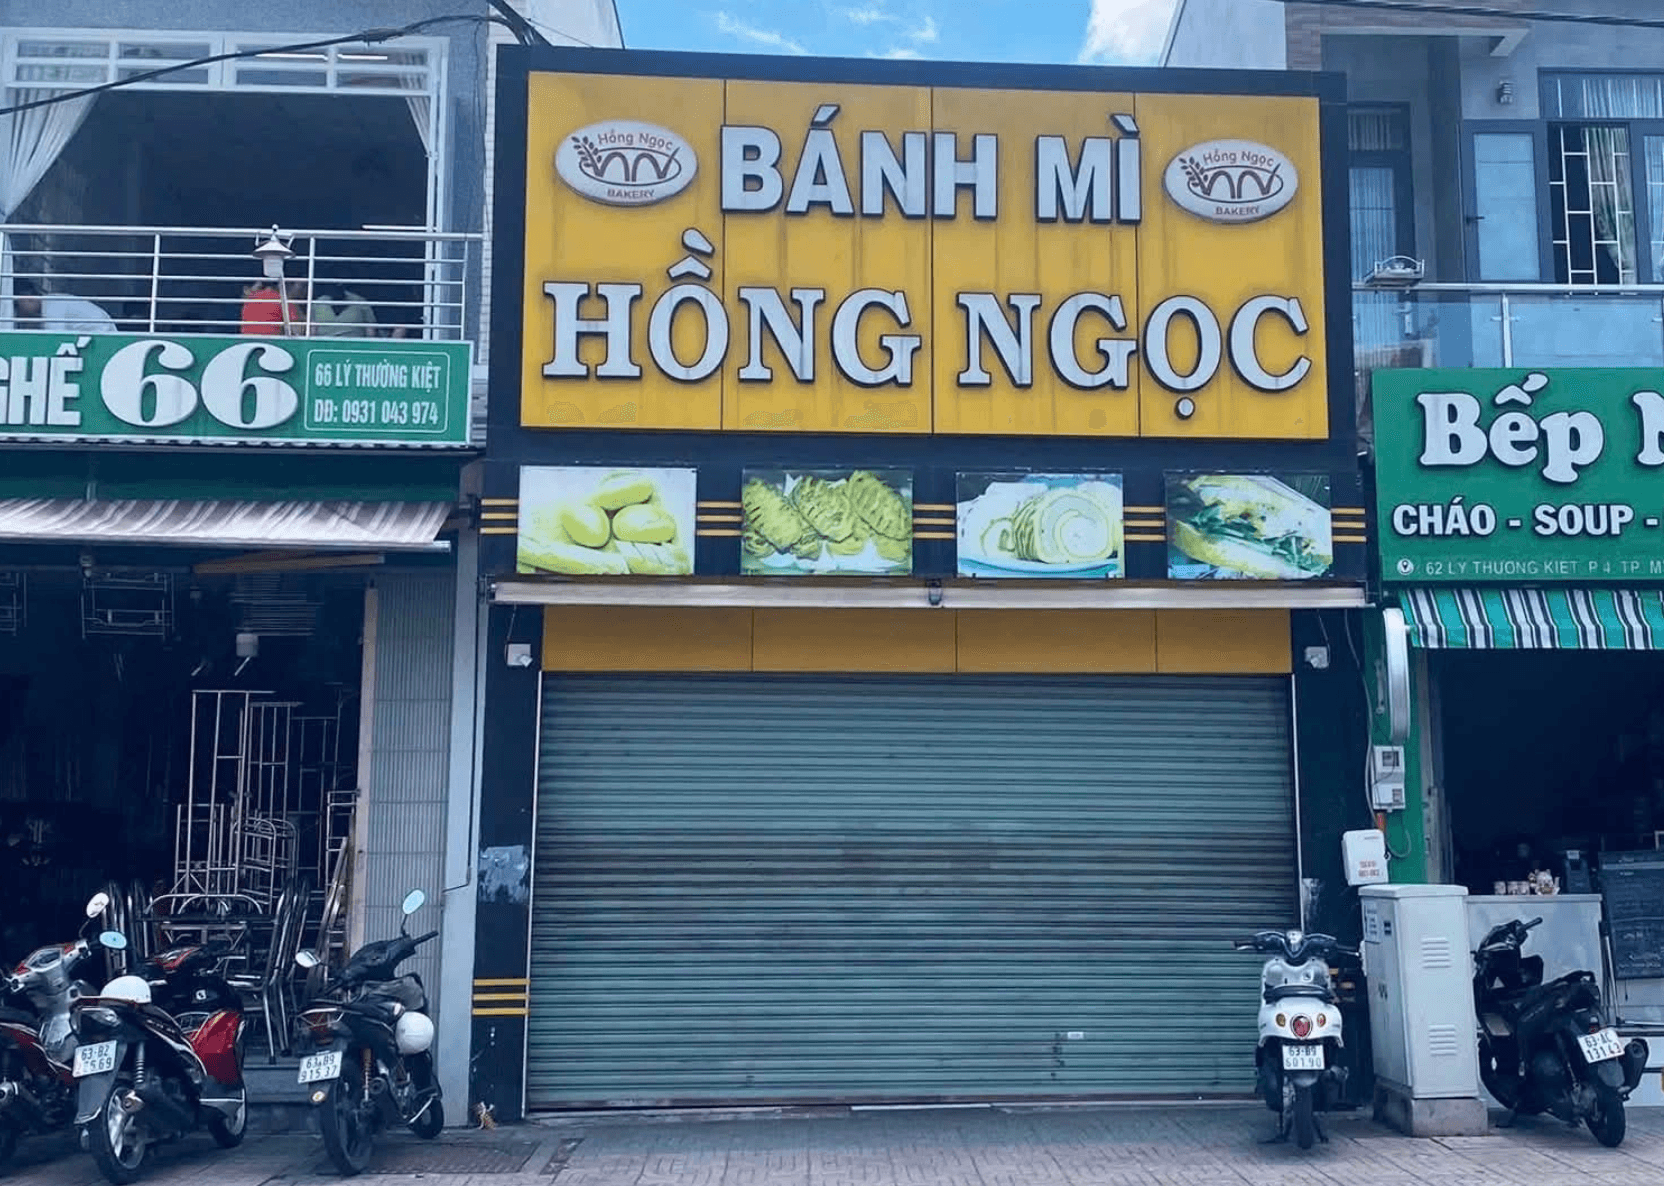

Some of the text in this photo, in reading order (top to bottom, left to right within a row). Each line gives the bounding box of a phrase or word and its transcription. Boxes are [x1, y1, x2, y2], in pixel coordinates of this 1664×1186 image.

[720, 104, 1141, 223] BÁNH MÌ
[607, 189, 655, 200] BAKERY
[1215, 205, 1260, 216] BAKERY
[542, 227, 1312, 419] HỒNG NGỌC
[0, 336, 299, 430] HẾ 66
[315, 358, 441, 393] 66 LÝ THƯỜNG KIỆT
[342, 399, 376, 424] 0931
[381, 401, 408, 425] 043
[412, 401, 439, 425] 974
[1417, 372, 1604, 483] Bếp
[1393, 496, 1497, 536] CHÁO
[1534, 504, 1635, 536] SOUP
[1425, 562, 1443, 575] 62
